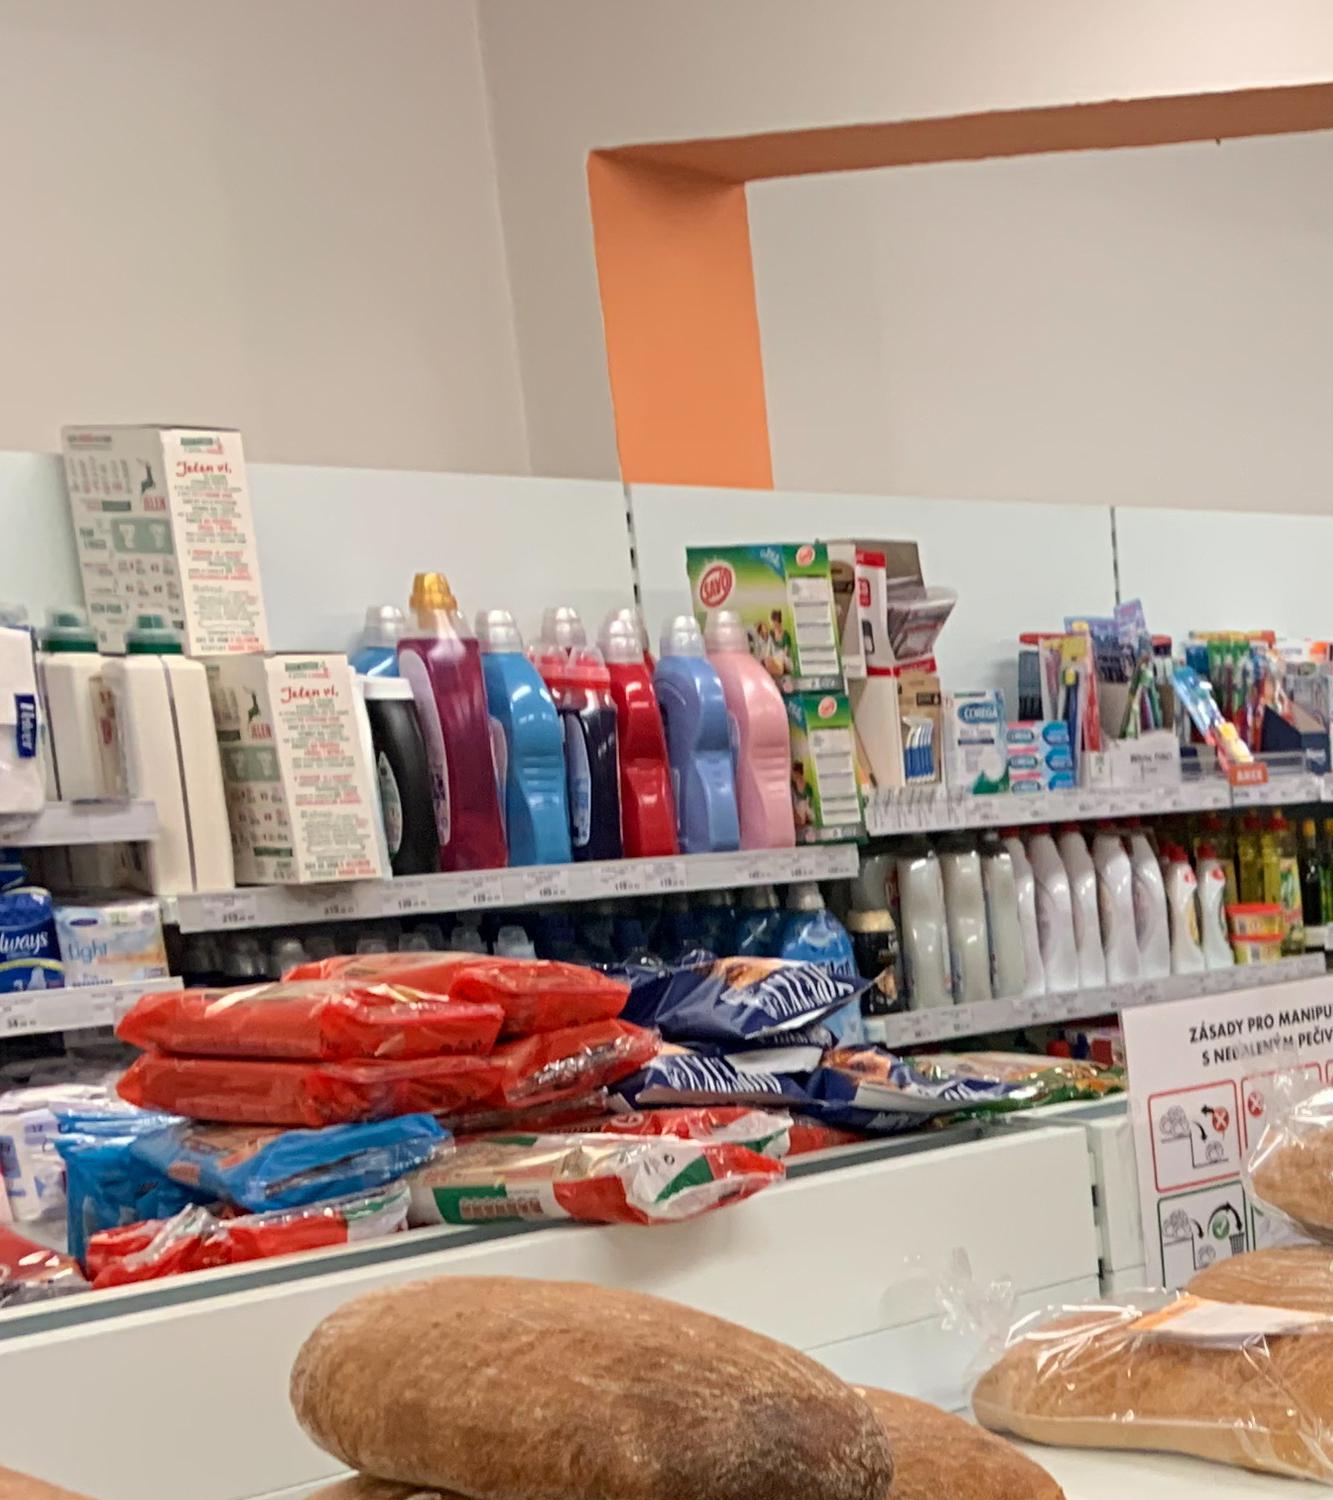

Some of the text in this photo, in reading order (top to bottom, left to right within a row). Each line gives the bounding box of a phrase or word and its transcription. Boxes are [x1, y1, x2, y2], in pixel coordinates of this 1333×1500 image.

[964, 707, 998, 721] COREGA
[0, 931, 49, 955] lways
[1189, 1019, 1244, 1044] ZÁSADY
[1248, 1013, 1275, 1033] PRO
[1202, 1050, 1210, 1067] S
